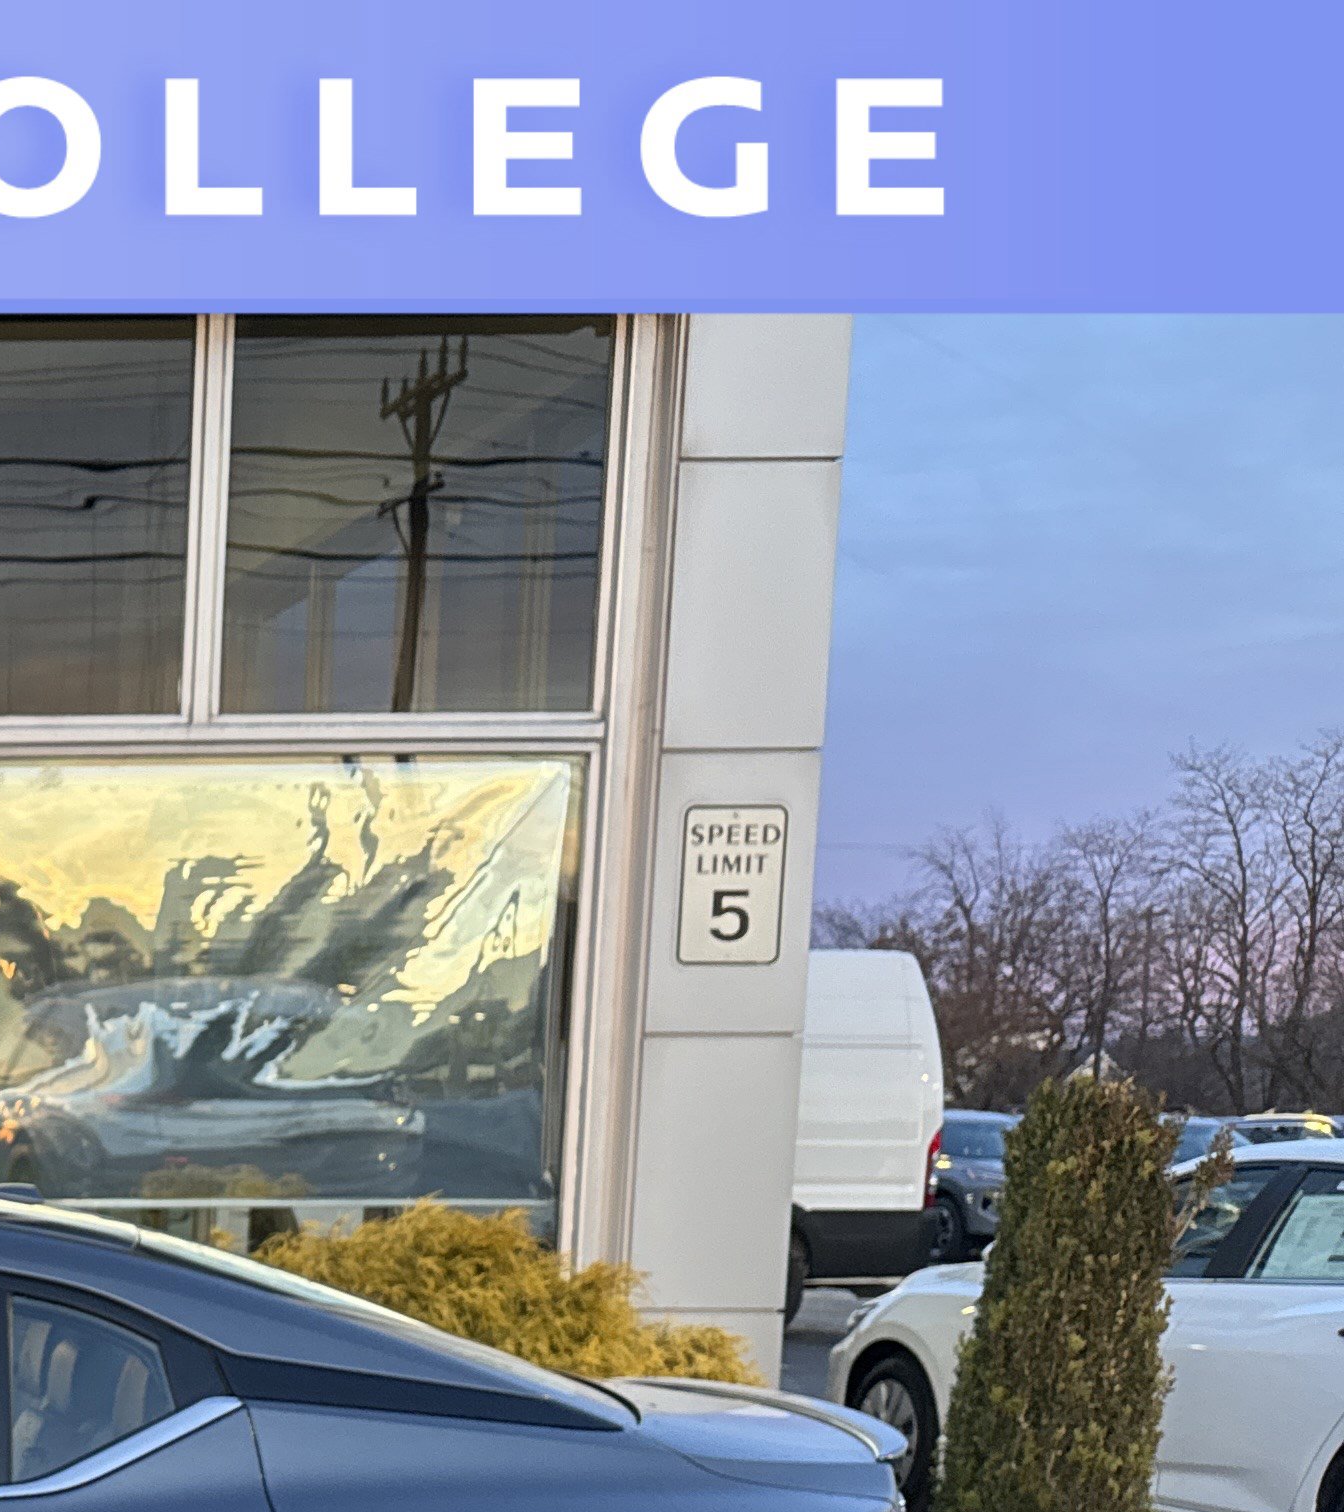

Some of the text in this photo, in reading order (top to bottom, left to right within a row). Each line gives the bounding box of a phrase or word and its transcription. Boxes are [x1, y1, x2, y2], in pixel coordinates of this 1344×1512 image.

[690, 823, 782, 846] SPEED
[696, 852, 769, 875] LIMIT
[710, 889, 750, 941] 5
